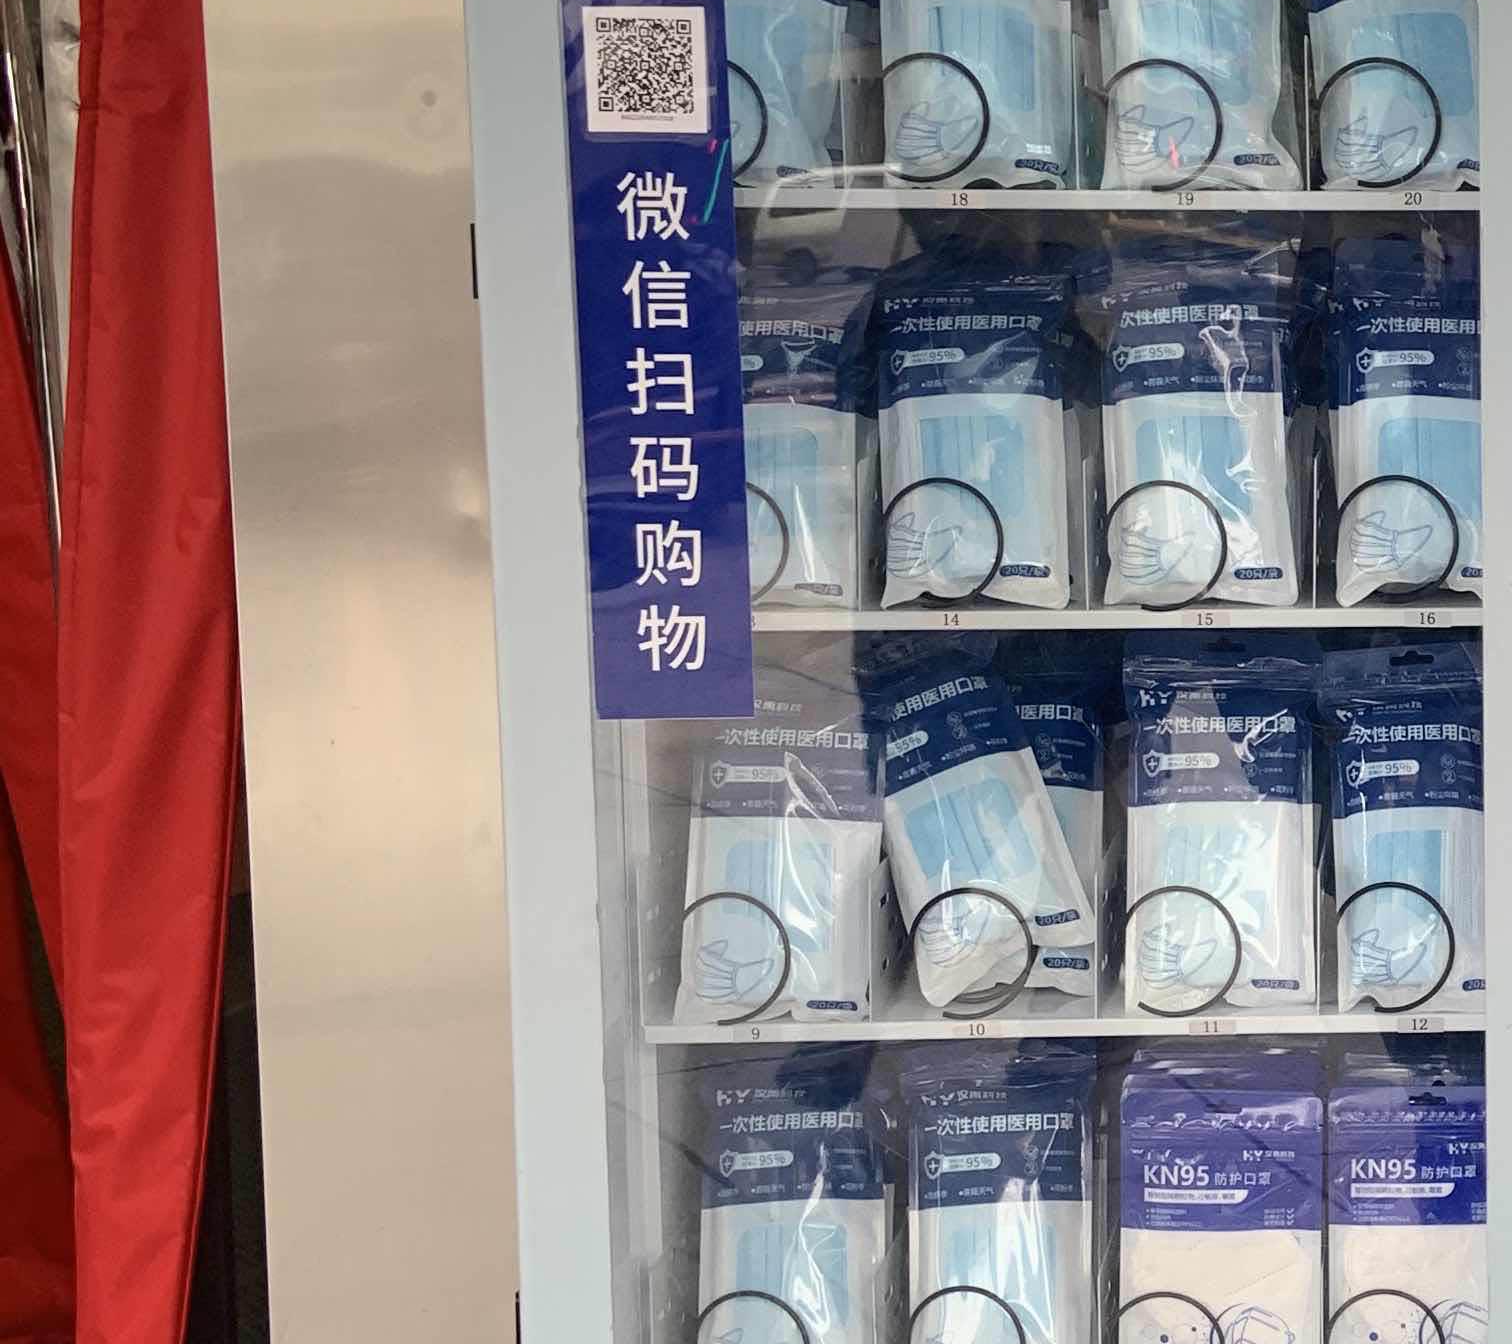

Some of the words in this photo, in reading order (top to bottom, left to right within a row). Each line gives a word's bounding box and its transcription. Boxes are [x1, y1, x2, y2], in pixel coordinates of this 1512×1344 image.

[952, 192, 968, 206] 18
[1176, 192, 1194, 205] 19
[1404, 192, 1422, 205] 20
[1356, 317, 1481, 334] 一次性使用医用
[1400, 351, 1429, 363] 95%
[615, 171, 707, 672] 微信扫码购物
[944, 613, 960, 627] 14
[1197, 613, 1213, 626] 15
[1419, 612, 1436, 625] 16
[1015, 703, 1085, 722] 医用口罩
[1143, 716, 1296, 735] 一次性使用医用口罩
[714, 727, 869, 750] 一次性使用医用口罩
[1184, 755, 1212, 767] 95%
[1384, 762, 1413, 774] 95%
[968, 1023, 985, 1037] 10
[1203, 1020, 1220, 1033] 11
[1411, 1018, 1428, 1031] 12
[751, 1027, 760, 1041] 9
[924, 1112, 1075, 1136] 一次性使用医用口罩
[966, 1155, 994, 1168] 95%
[1143, 1164, 1210, 1186] KN95
[1214, 1172, 1272, 1186] 防护口罩
[1351, 1158, 1417, 1180] KN95
[1421, 1164, 1477, 1180] 防护口罩
